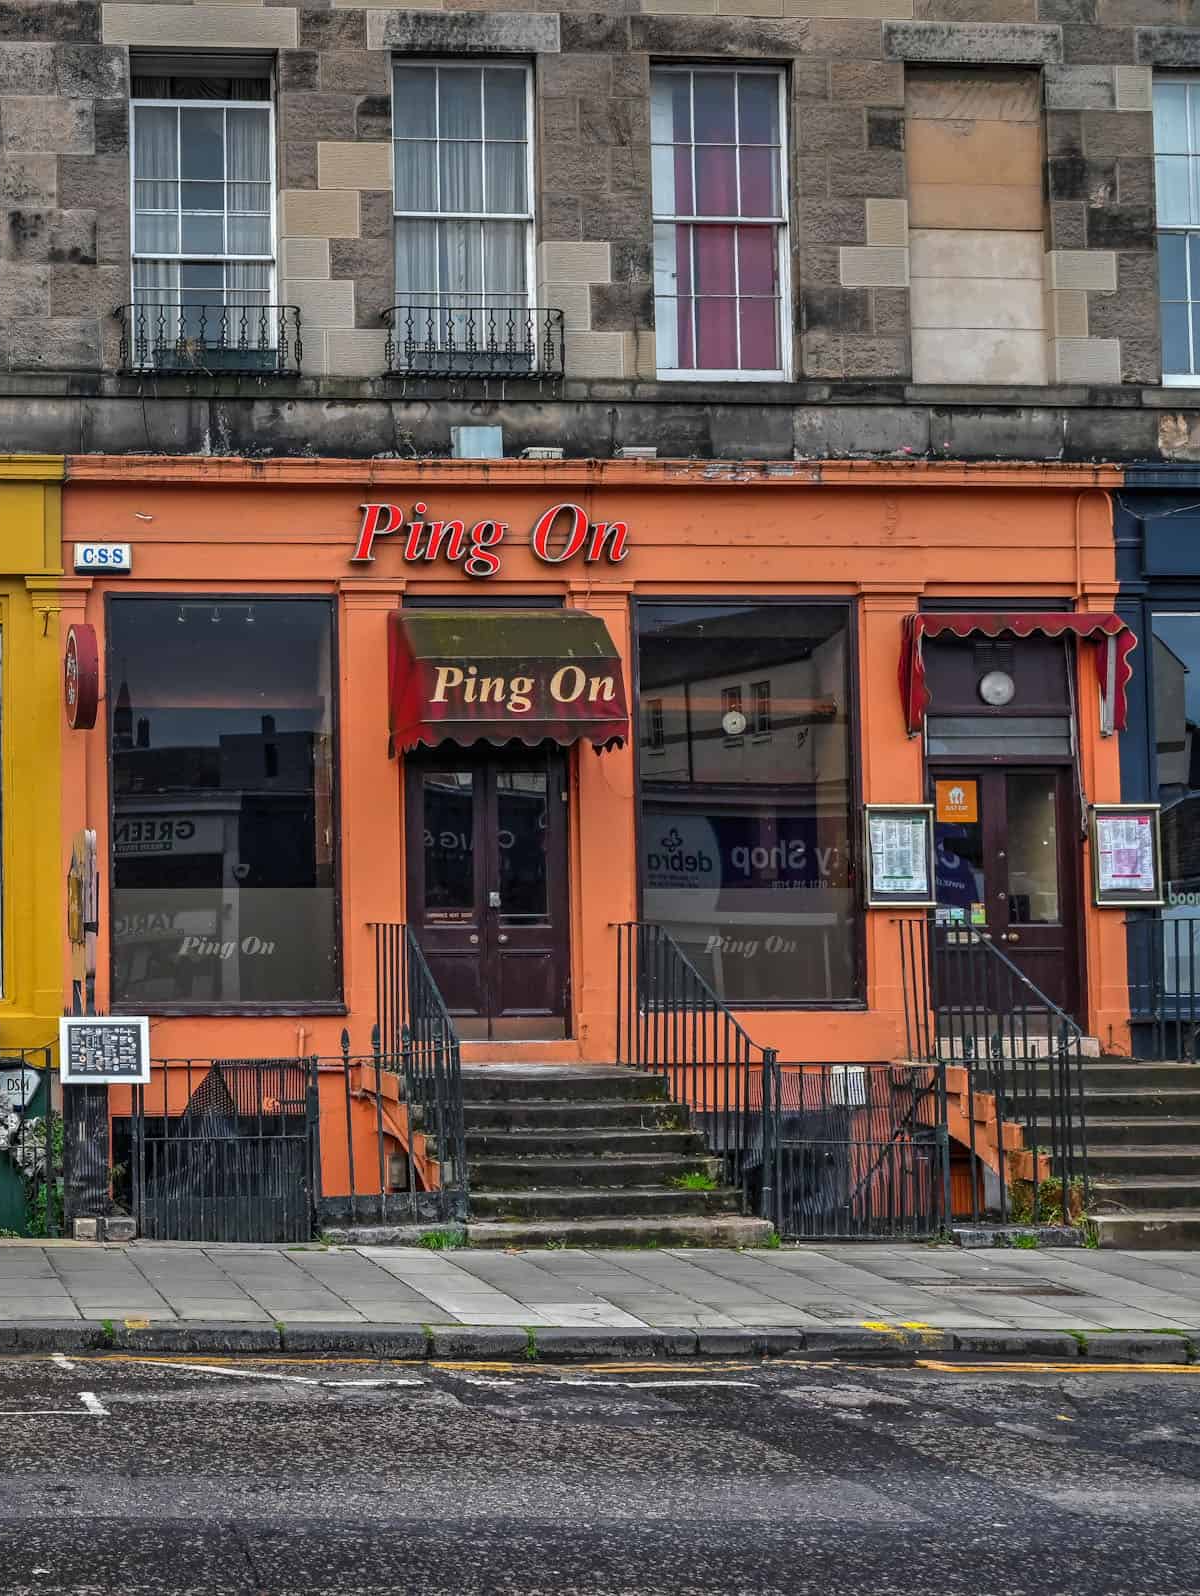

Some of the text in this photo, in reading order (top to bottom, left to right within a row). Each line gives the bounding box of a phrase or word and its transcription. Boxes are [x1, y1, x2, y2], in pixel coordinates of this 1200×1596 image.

[349, 502, 629, 576] Ping On
[430, 666, 616, 713] Ping On
[178, 935, 275, 959] Ping On
[704, 935, 799, 958] Ping On
